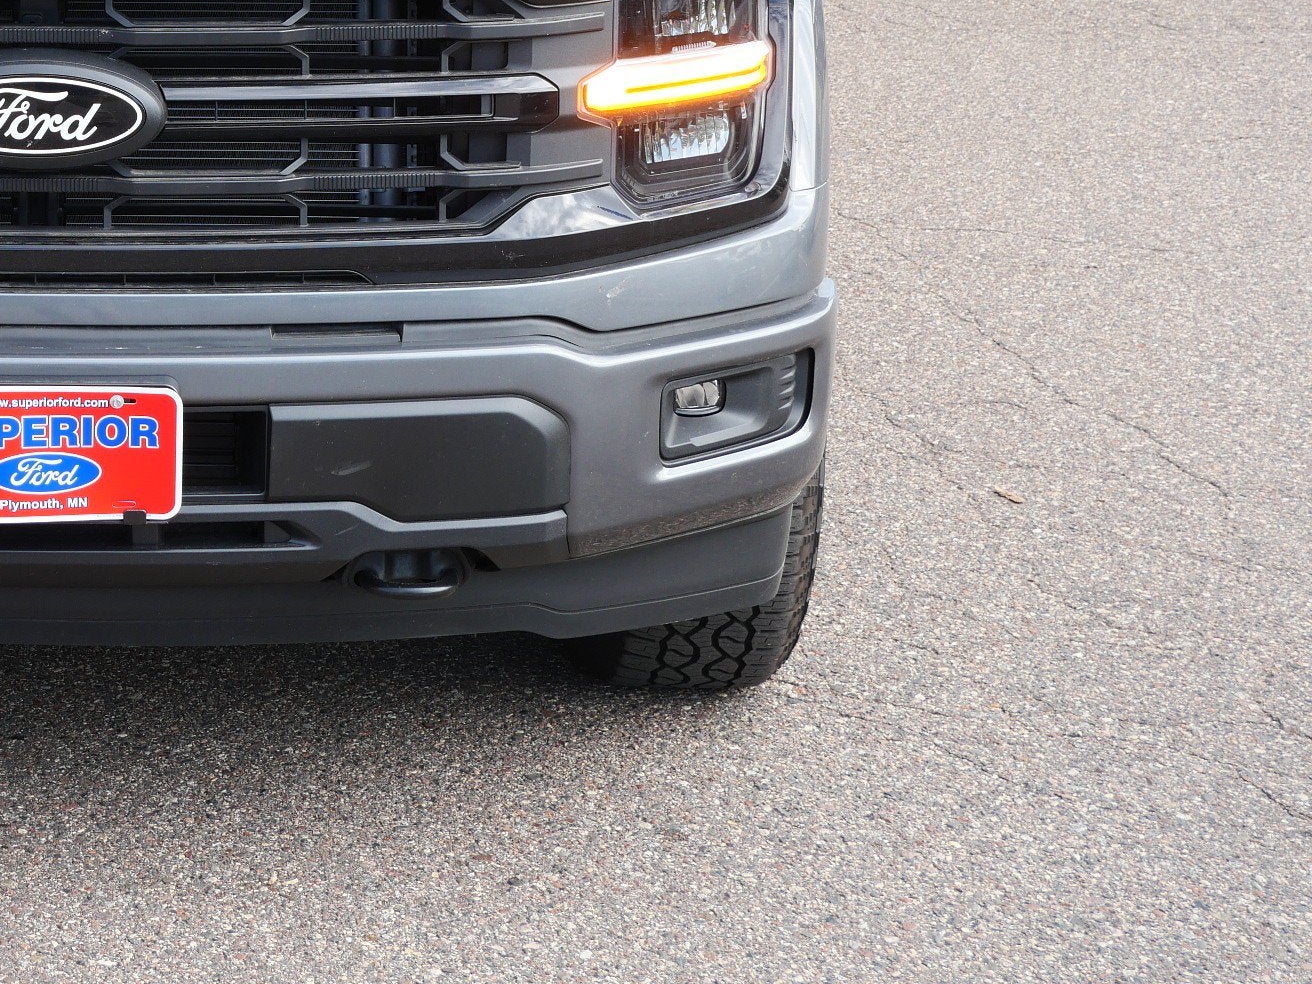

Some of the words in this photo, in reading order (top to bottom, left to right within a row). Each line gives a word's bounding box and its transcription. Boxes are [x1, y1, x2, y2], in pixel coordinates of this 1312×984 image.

[10, 457, 79, 488] Ford
[0, 498, 64, 512] Plymouth,
[67, 497, 88, 509] MN
